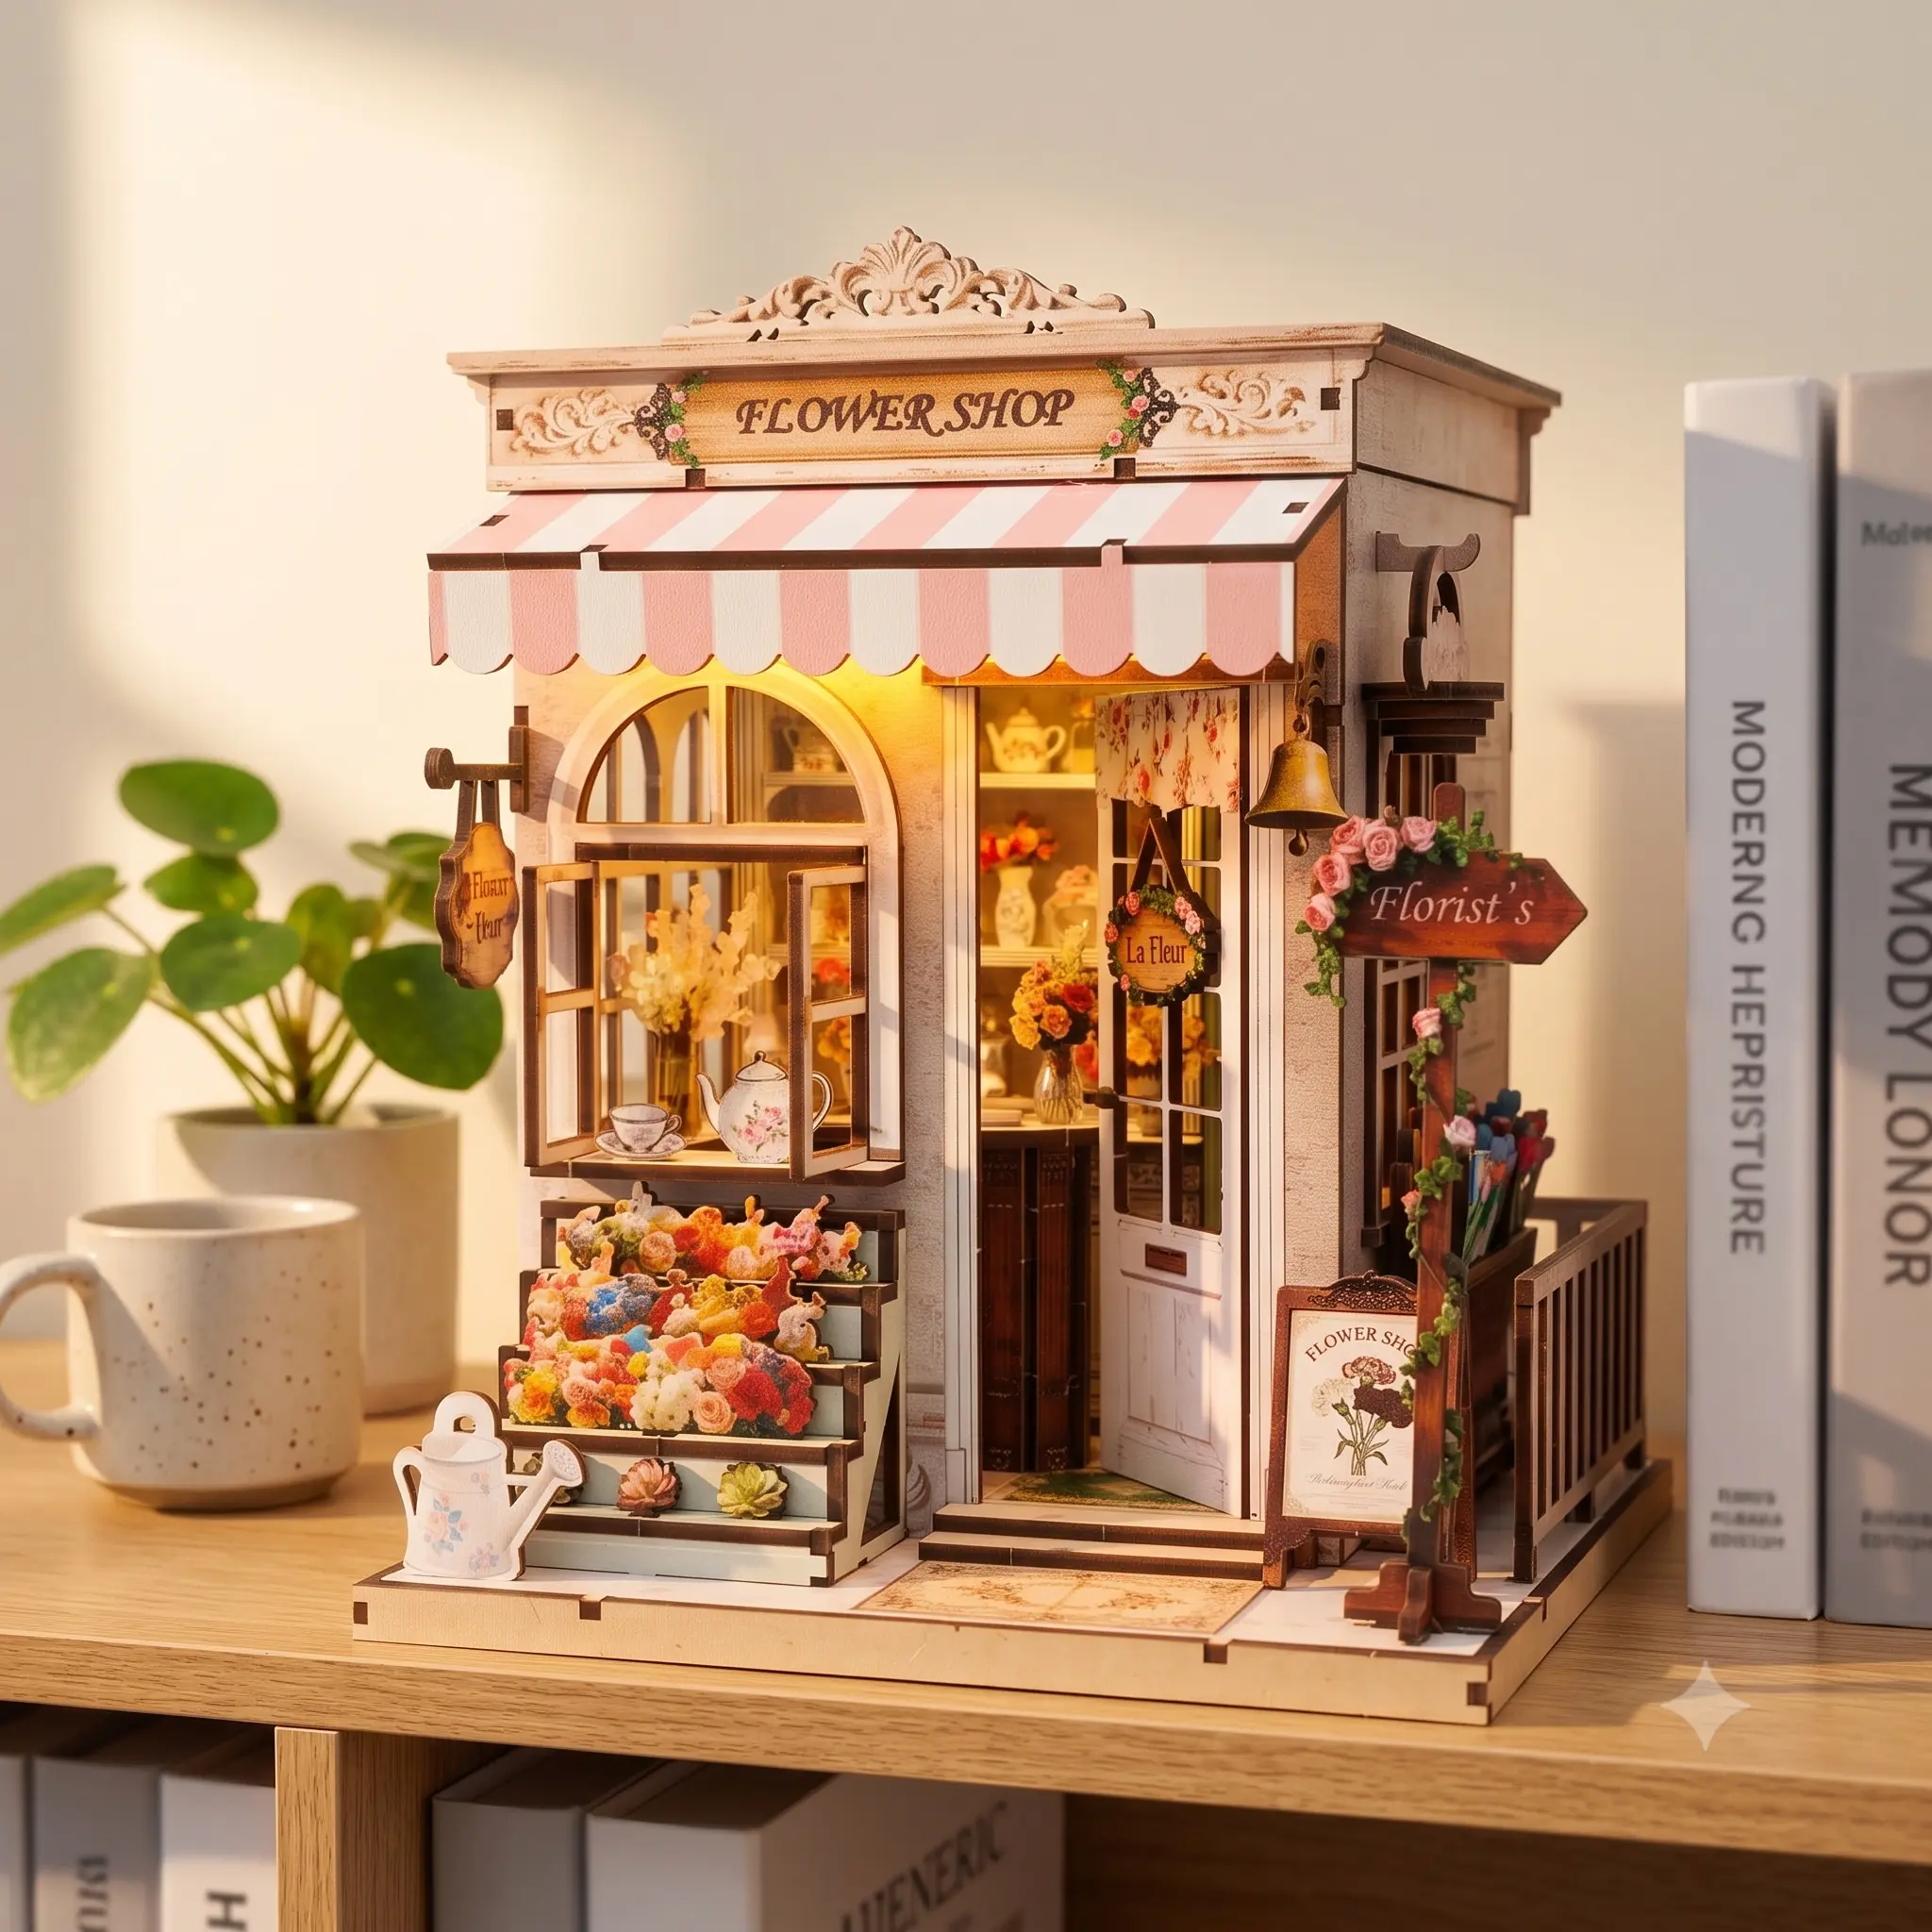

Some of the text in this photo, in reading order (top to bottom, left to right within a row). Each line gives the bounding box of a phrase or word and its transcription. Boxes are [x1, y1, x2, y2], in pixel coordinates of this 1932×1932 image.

[735, 388, 1075, 438] FLOWER SHOP
[1370, 880, 1534, 925] Florist's
[1126, 935, 1188, 965] La Fleur
[1729, 700, 1767, 1256] MODERNG HEPRISTURE
[1885, 1072, 1932, 1288] LONOR
[1305, 1326, 1416, 1362] FLOWER SHO
